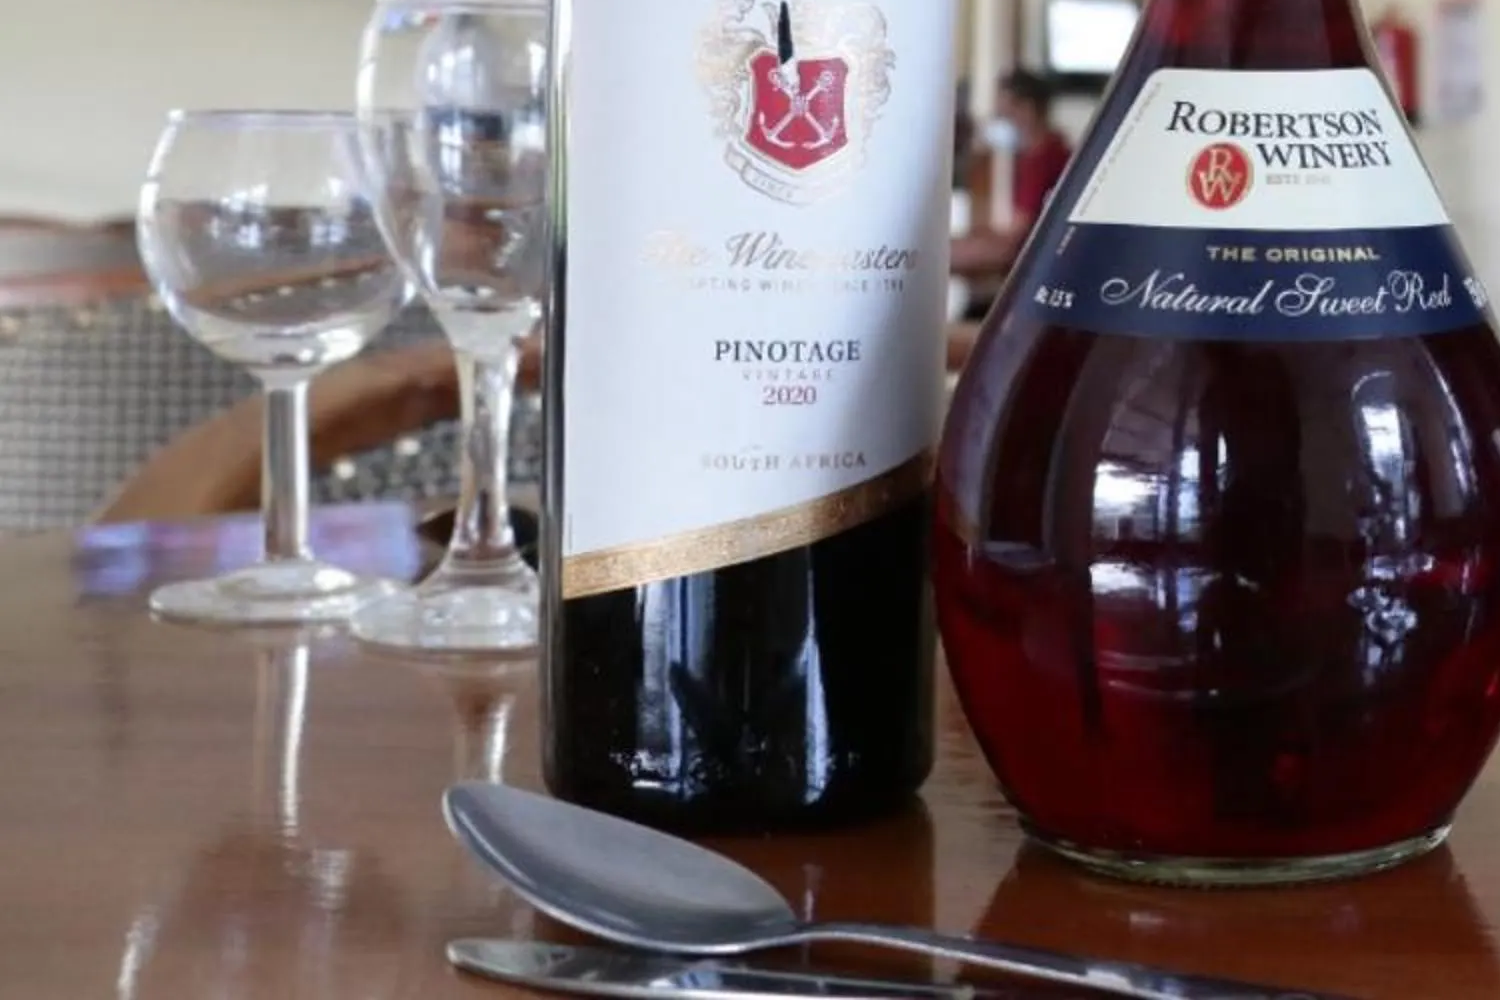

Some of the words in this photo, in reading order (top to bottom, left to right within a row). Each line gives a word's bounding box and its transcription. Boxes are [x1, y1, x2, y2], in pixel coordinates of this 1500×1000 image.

[1166, 100, 1384, 139] ROBERTSON
[1256, 141, 1393, 170] WINERY
[1207, 246, 1257, 262] THE
[1266, 246, 1381, 263] ORIGINAL
[1101, 268, 1275, 317] Natural
[1274, 271, 1389, 317] Sweet
[1387, 269, 1453, 312] Red
[714, 340, 863, 363] PINOTAGE
[762, 385, 818, 405] 2020
[701, 454, 781, 472] SOUTH
[789, 451, 868, 469] AFRICA
